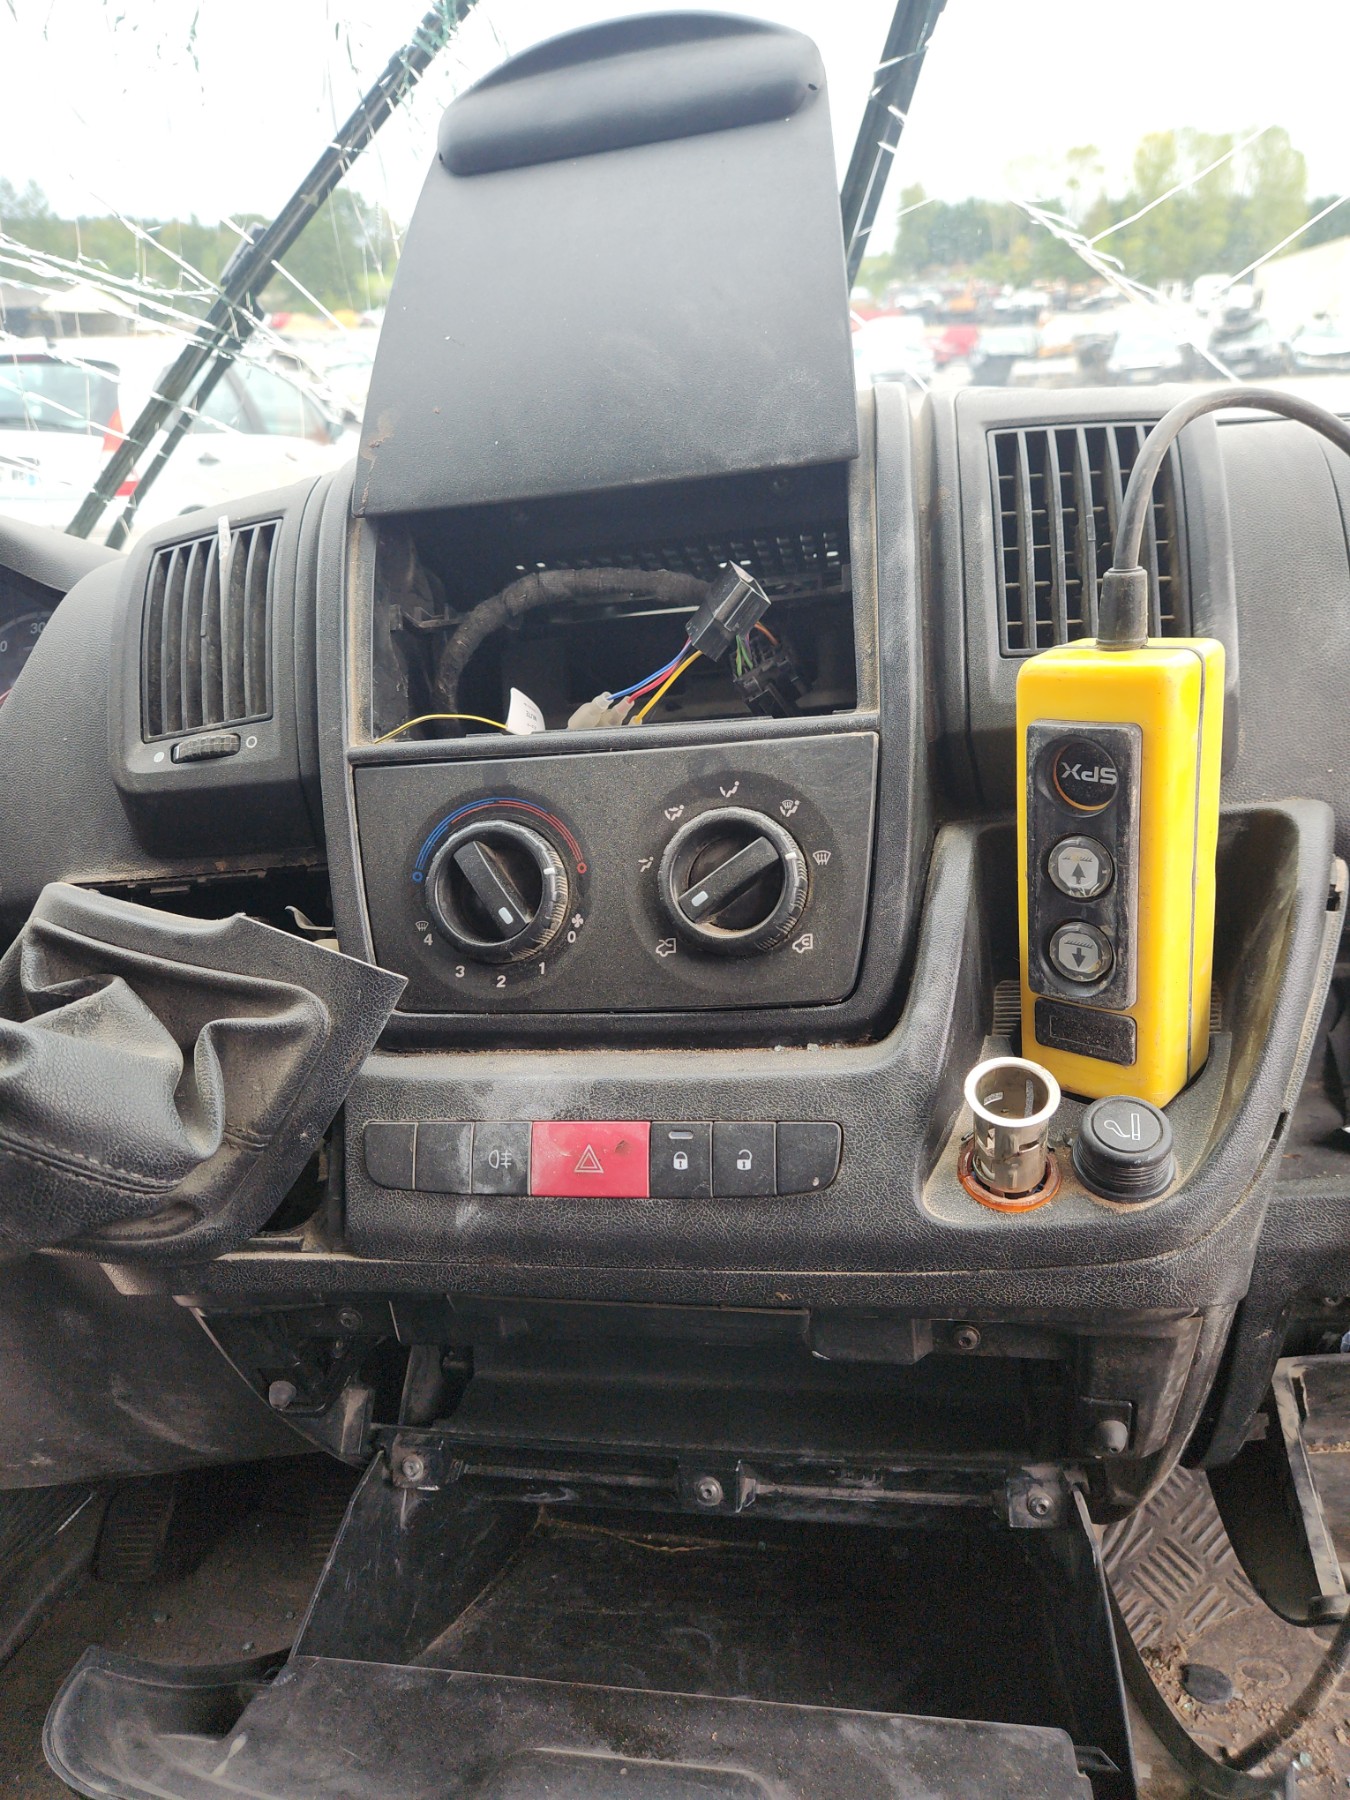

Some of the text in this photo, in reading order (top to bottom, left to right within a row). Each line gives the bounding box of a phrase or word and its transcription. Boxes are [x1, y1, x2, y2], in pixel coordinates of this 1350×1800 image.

[1061, 761, 1118, 785] SPX
[423, 933, 433, 946] 4
[567, 930, 577, 943] 0
[455, 965, 465, 978] 3
[538, 961, 546, 975] 1
[496, 975, 507, 988] 2
